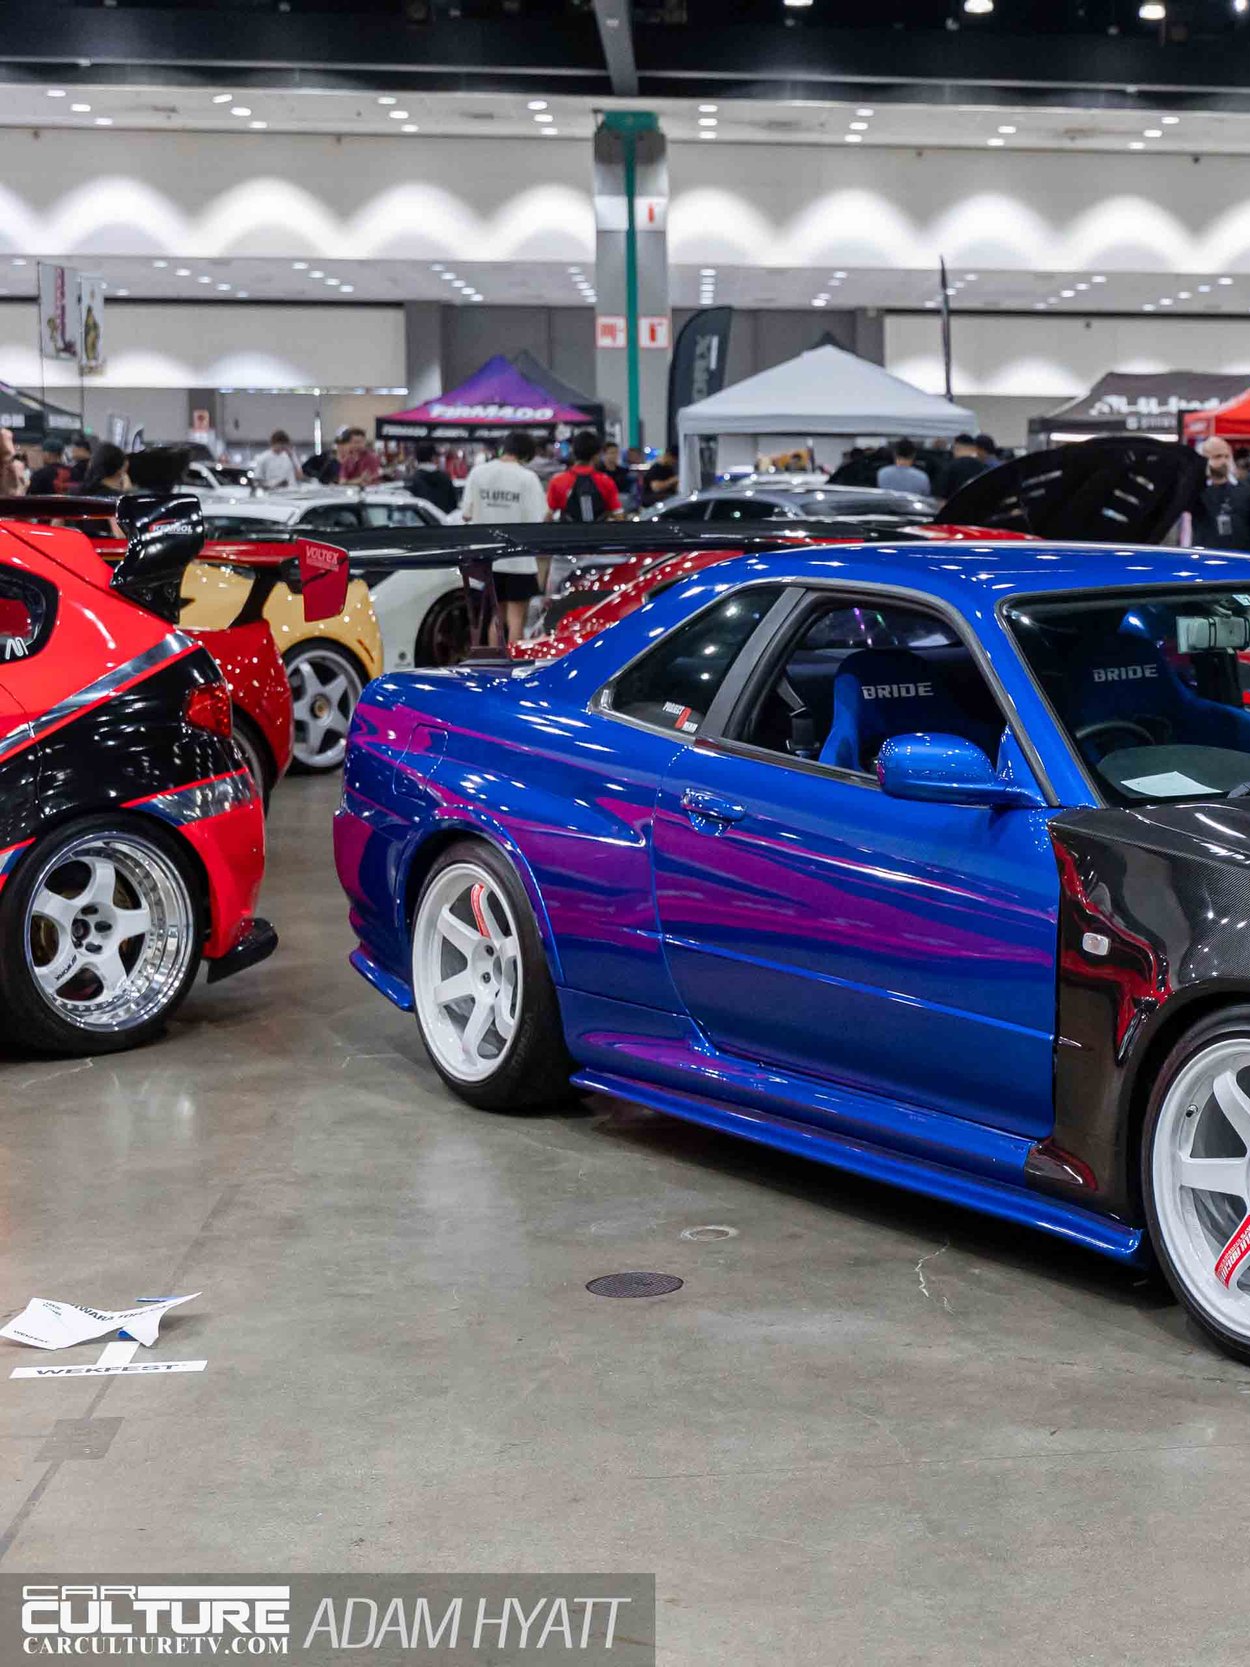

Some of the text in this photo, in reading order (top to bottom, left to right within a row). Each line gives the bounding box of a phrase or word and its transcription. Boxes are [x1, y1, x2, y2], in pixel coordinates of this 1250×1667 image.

[479, 489, 520, 503] CLUTCH
[305, 545, 340, 565] VOLTEX
[1093, 664, 1158, 683] BRIDE
[861, 682, 934, 700] BRIDE
[36, 1363, 180, 1375] WEKFEST
